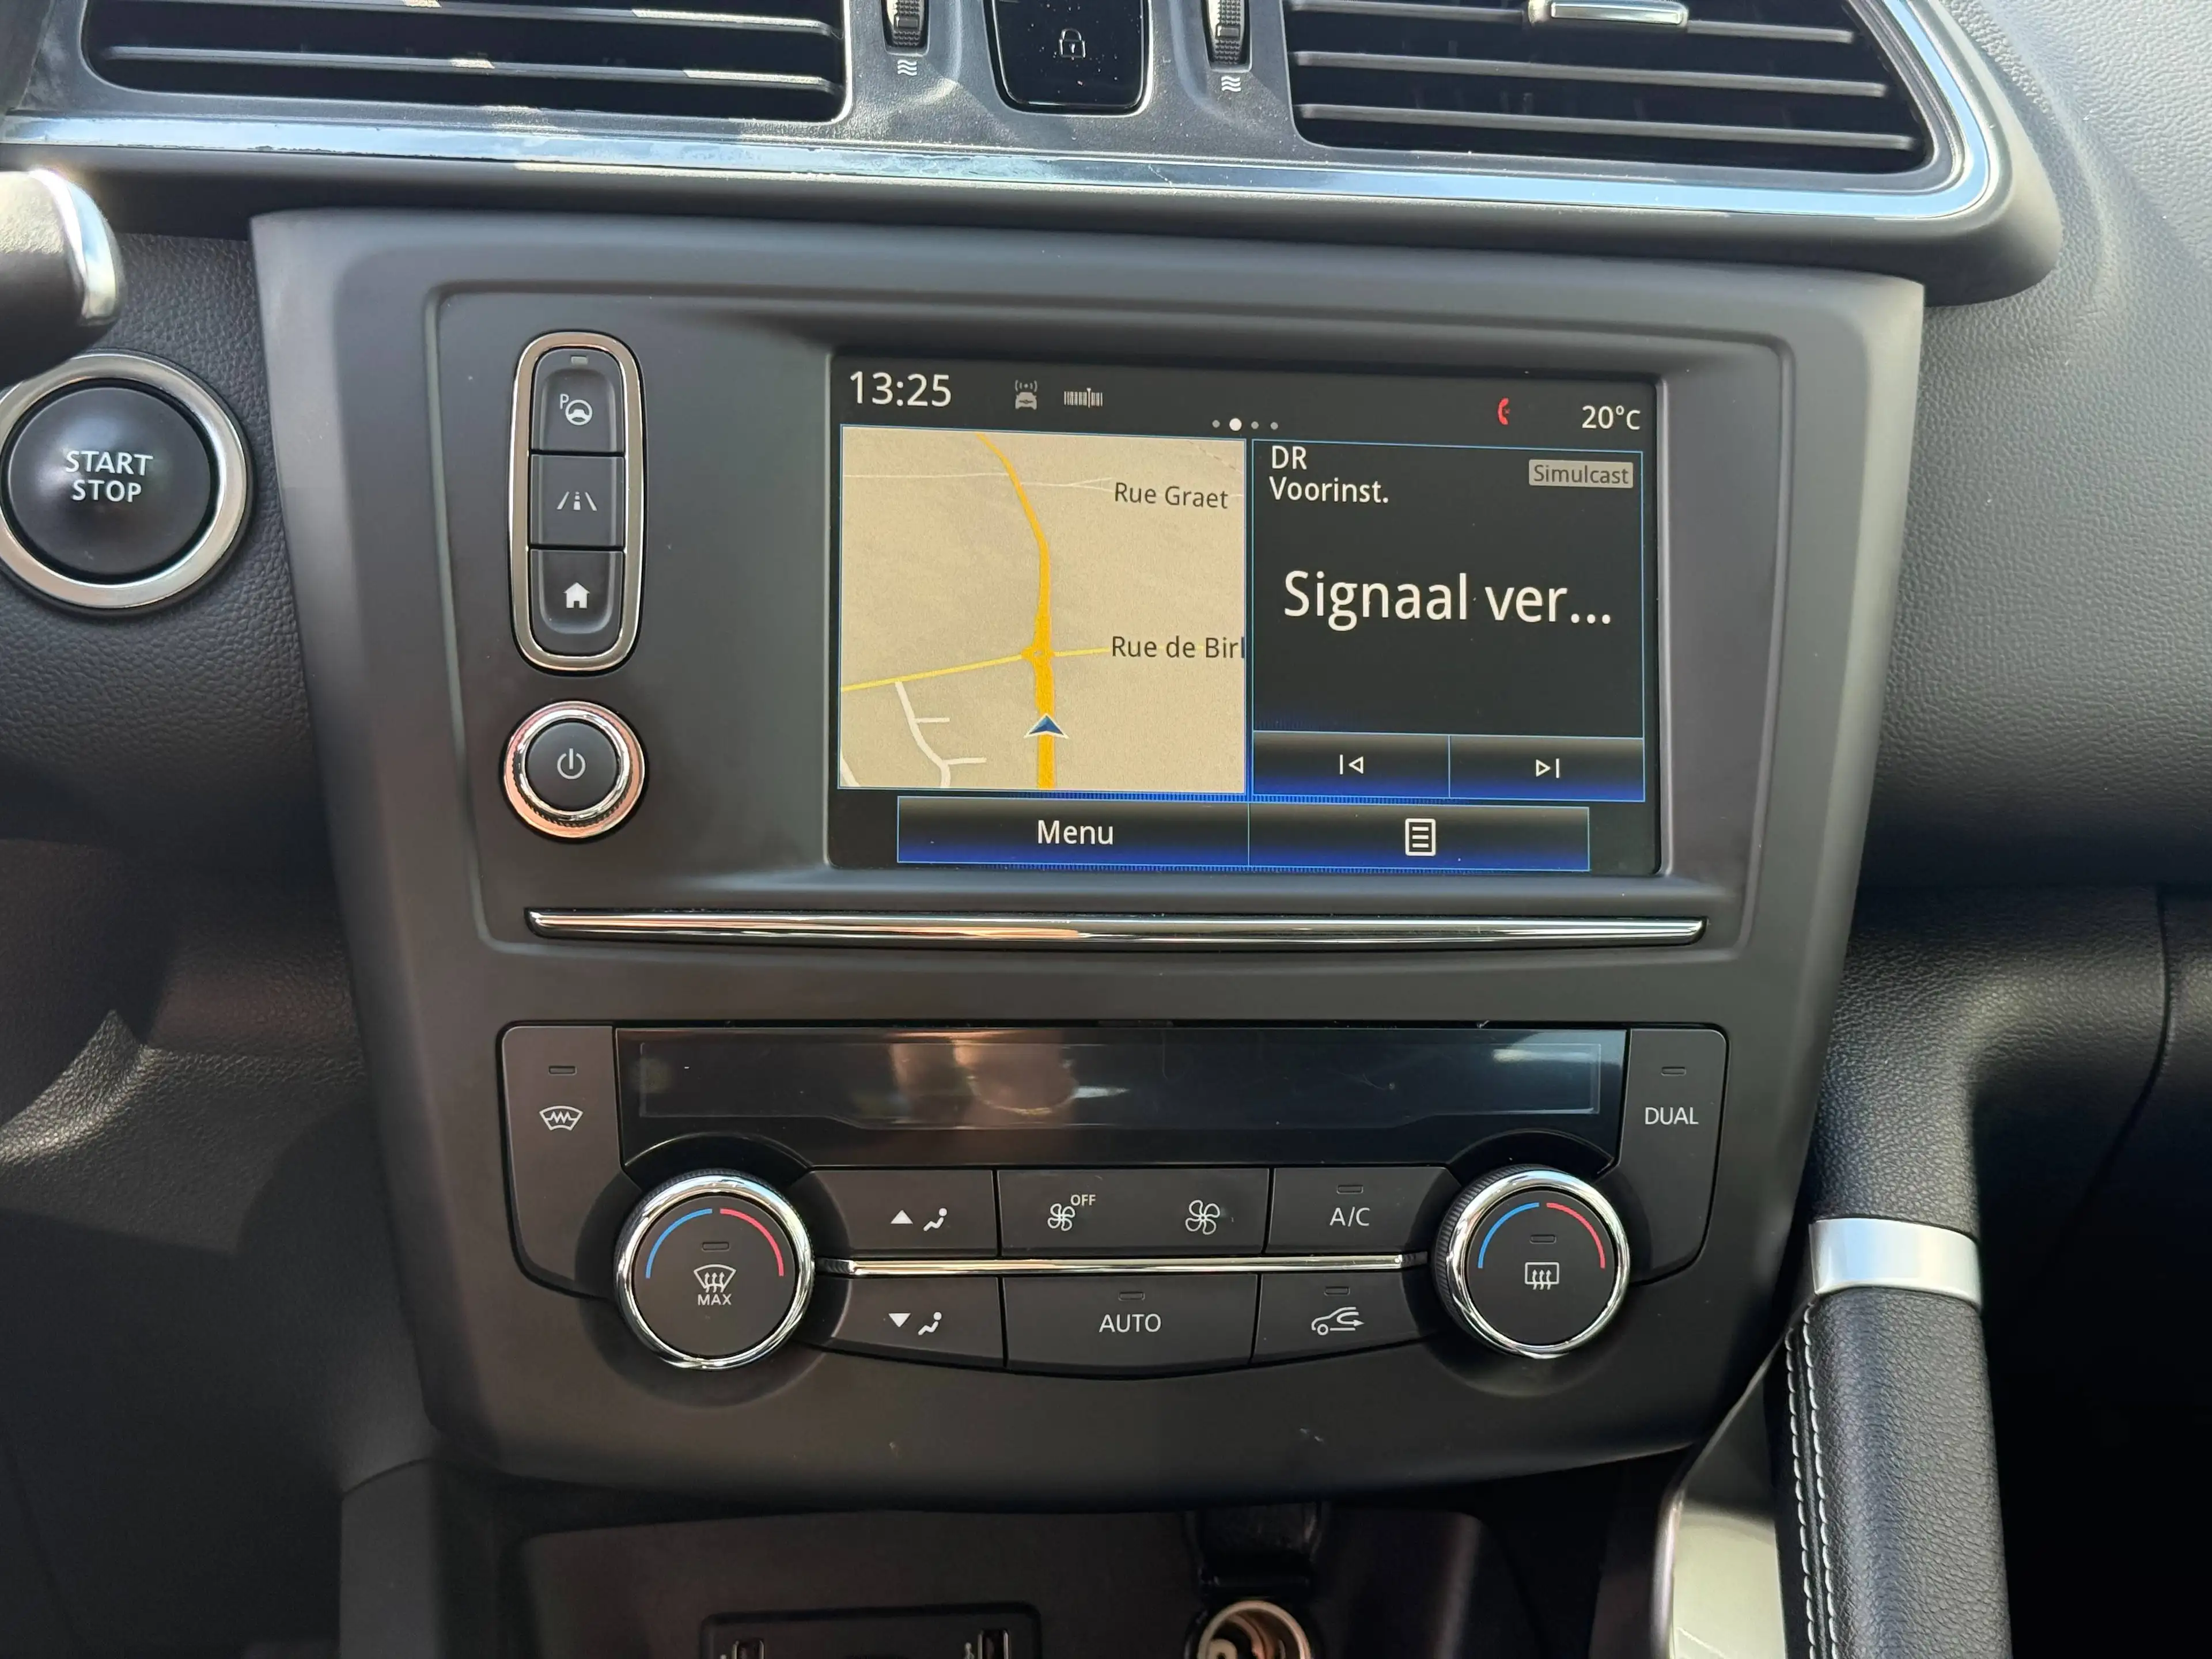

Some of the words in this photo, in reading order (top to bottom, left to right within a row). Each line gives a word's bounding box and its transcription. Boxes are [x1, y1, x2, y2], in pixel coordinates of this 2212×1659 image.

[849, 370, 952, 407] 13:25
[559, 393, 570, 410] P
[65, 450, 154, 476] START
[1271, 445, 1308, 471] DR
[1533, 464, 1630, 485] Simulcast
[71, 479, 142, 503] STOP
[1114, 482, 1157, 505] Rue
[1164, 485, 1229, 510] Graet
[1268, 475, 1389, 504] Voorinst.
[1284, 570, 1467, 632] Signaal
[1484, 586, 1611, 625] ver...
[1112, 635, 1157, 658] Rue
[1165, 635, 1196, 659] de
[1037, 819, 1113, 846] Menu
[1644, 1106, 1699, 1126] DUAL
[1070, 1193, 1097, 1207] OFF
[1329, 1206, 1370, 1228] A/C
[697, 1293, 732, 1306] MAX
[1098, 1313, 1162, 1333] AUTO
